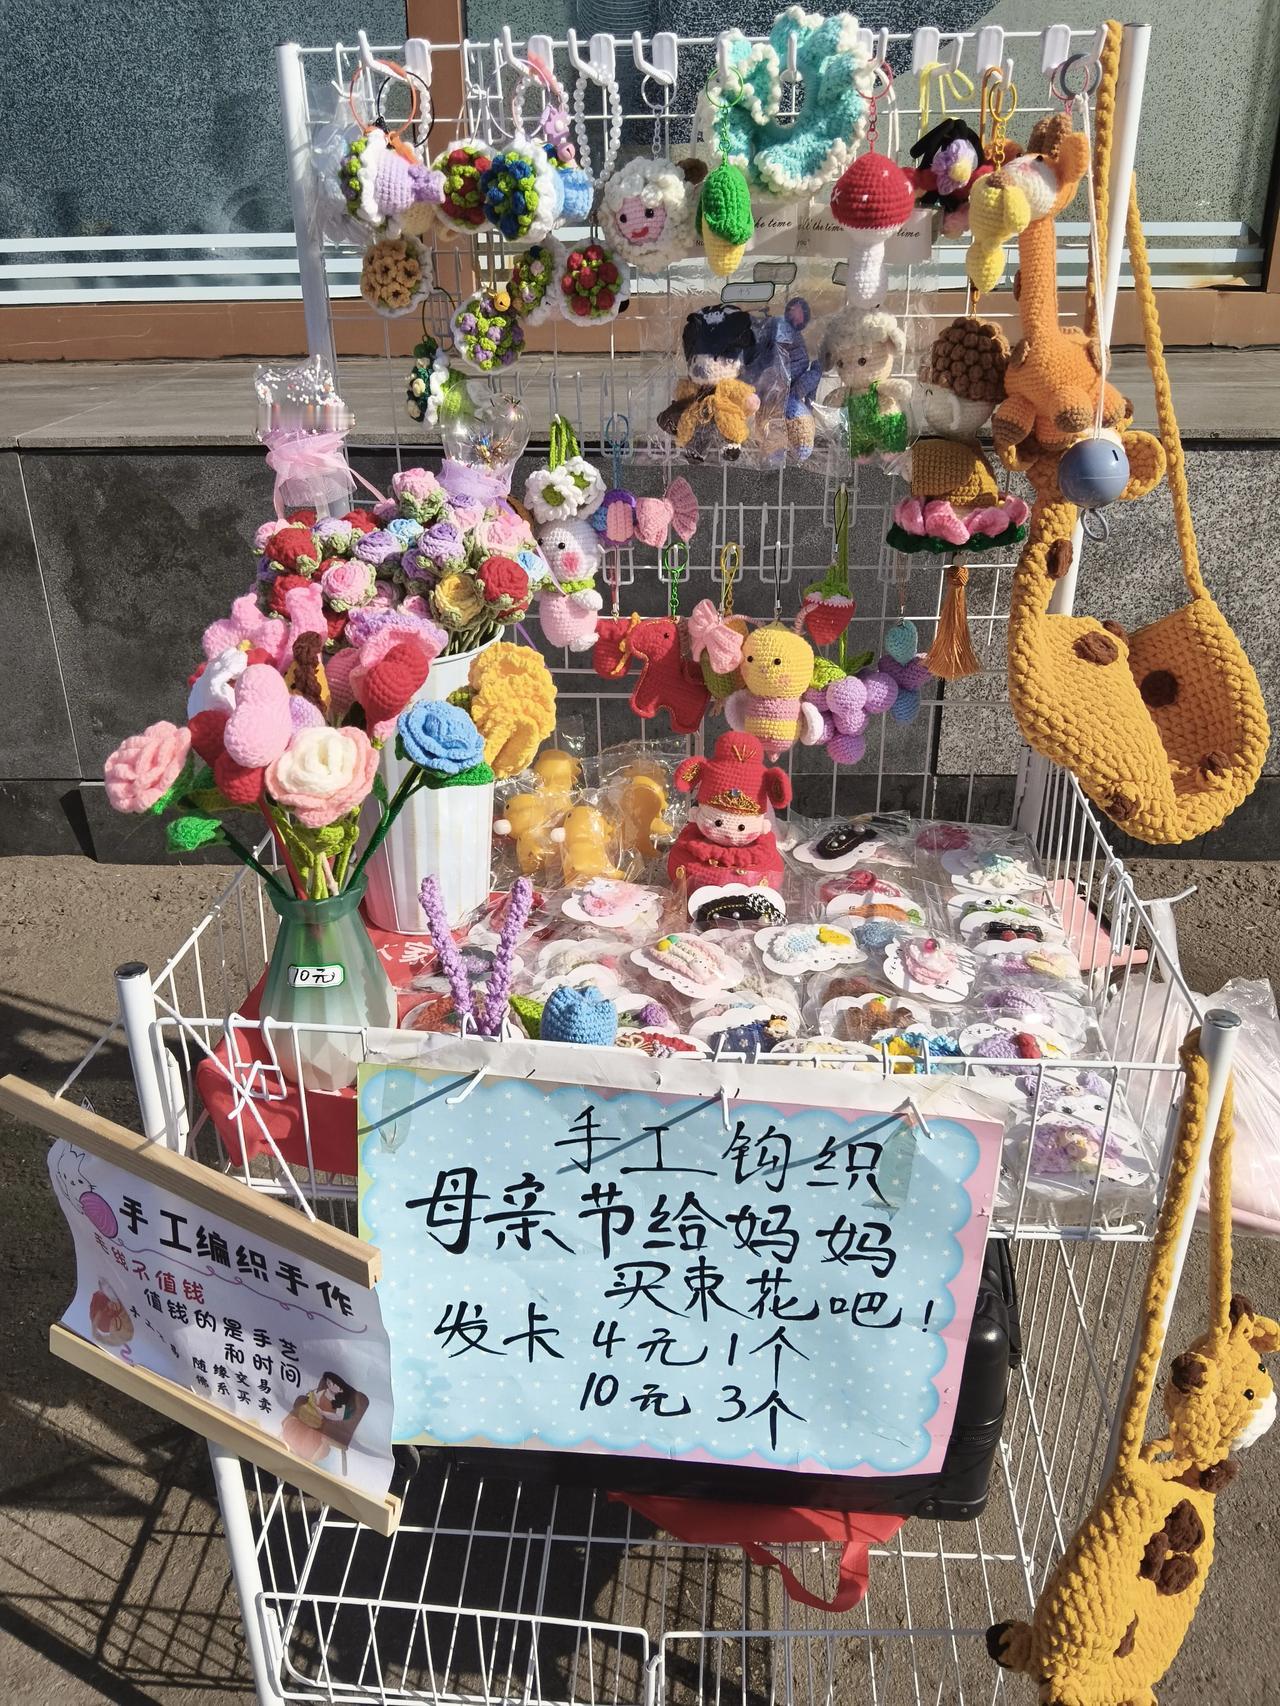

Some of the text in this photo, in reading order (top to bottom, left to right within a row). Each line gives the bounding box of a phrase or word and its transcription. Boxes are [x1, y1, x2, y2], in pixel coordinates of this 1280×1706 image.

[293, 968, 335, 984] 10元
[555, 1105, 887, 1204] 手工钩织
[119, 1195, 355, 1317] 手工编织手作
[405, 1166, 898, 1277] 母亲节给妈妈
[143, 1289, 300, 1362] 值钱的是手艺
[604, 1256, 935, 1333] 买束花吧!
[224, 1343, 302, 1388] 和时间
[579, 1372, 808, 1451] 10元3个
